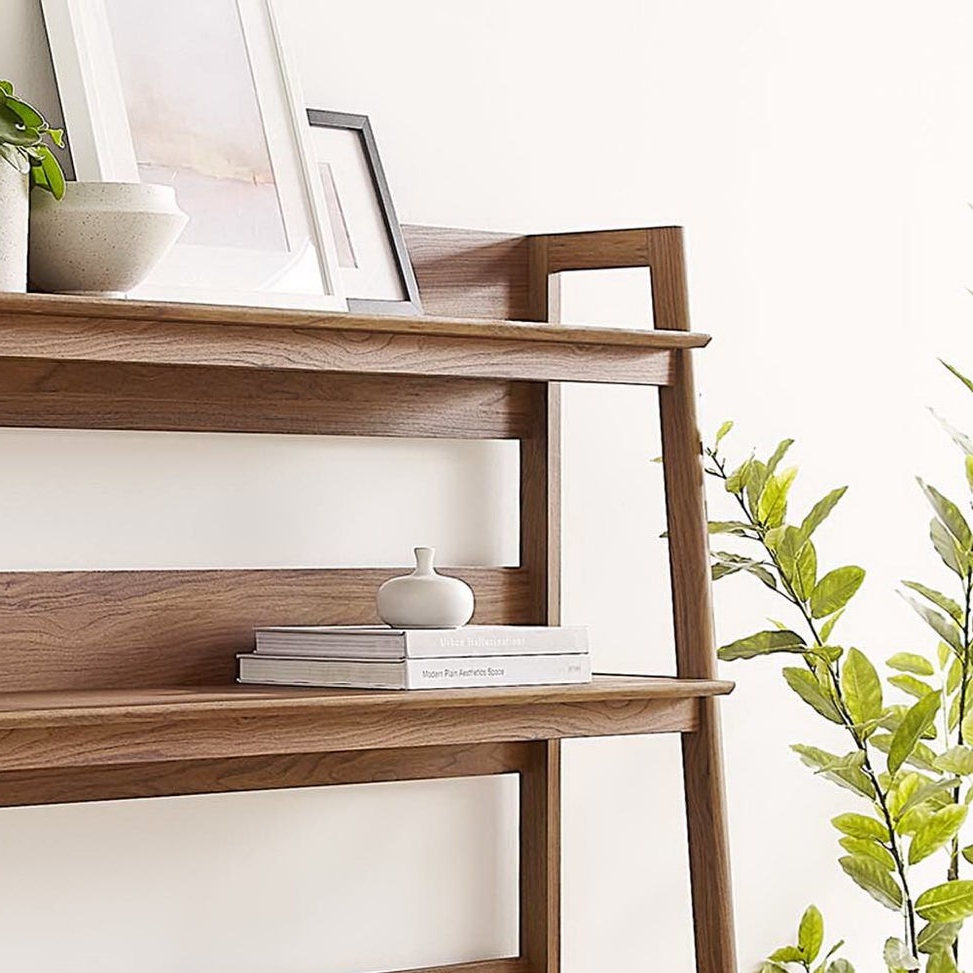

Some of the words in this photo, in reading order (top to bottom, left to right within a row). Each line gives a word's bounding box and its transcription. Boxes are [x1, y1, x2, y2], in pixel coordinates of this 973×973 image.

[422, 669, 444, 679] Modern
[444, 668, 458, 678] Plain
[459, 667, 487, 678] Aesthetics
[487, 666, 506, 677] Space
